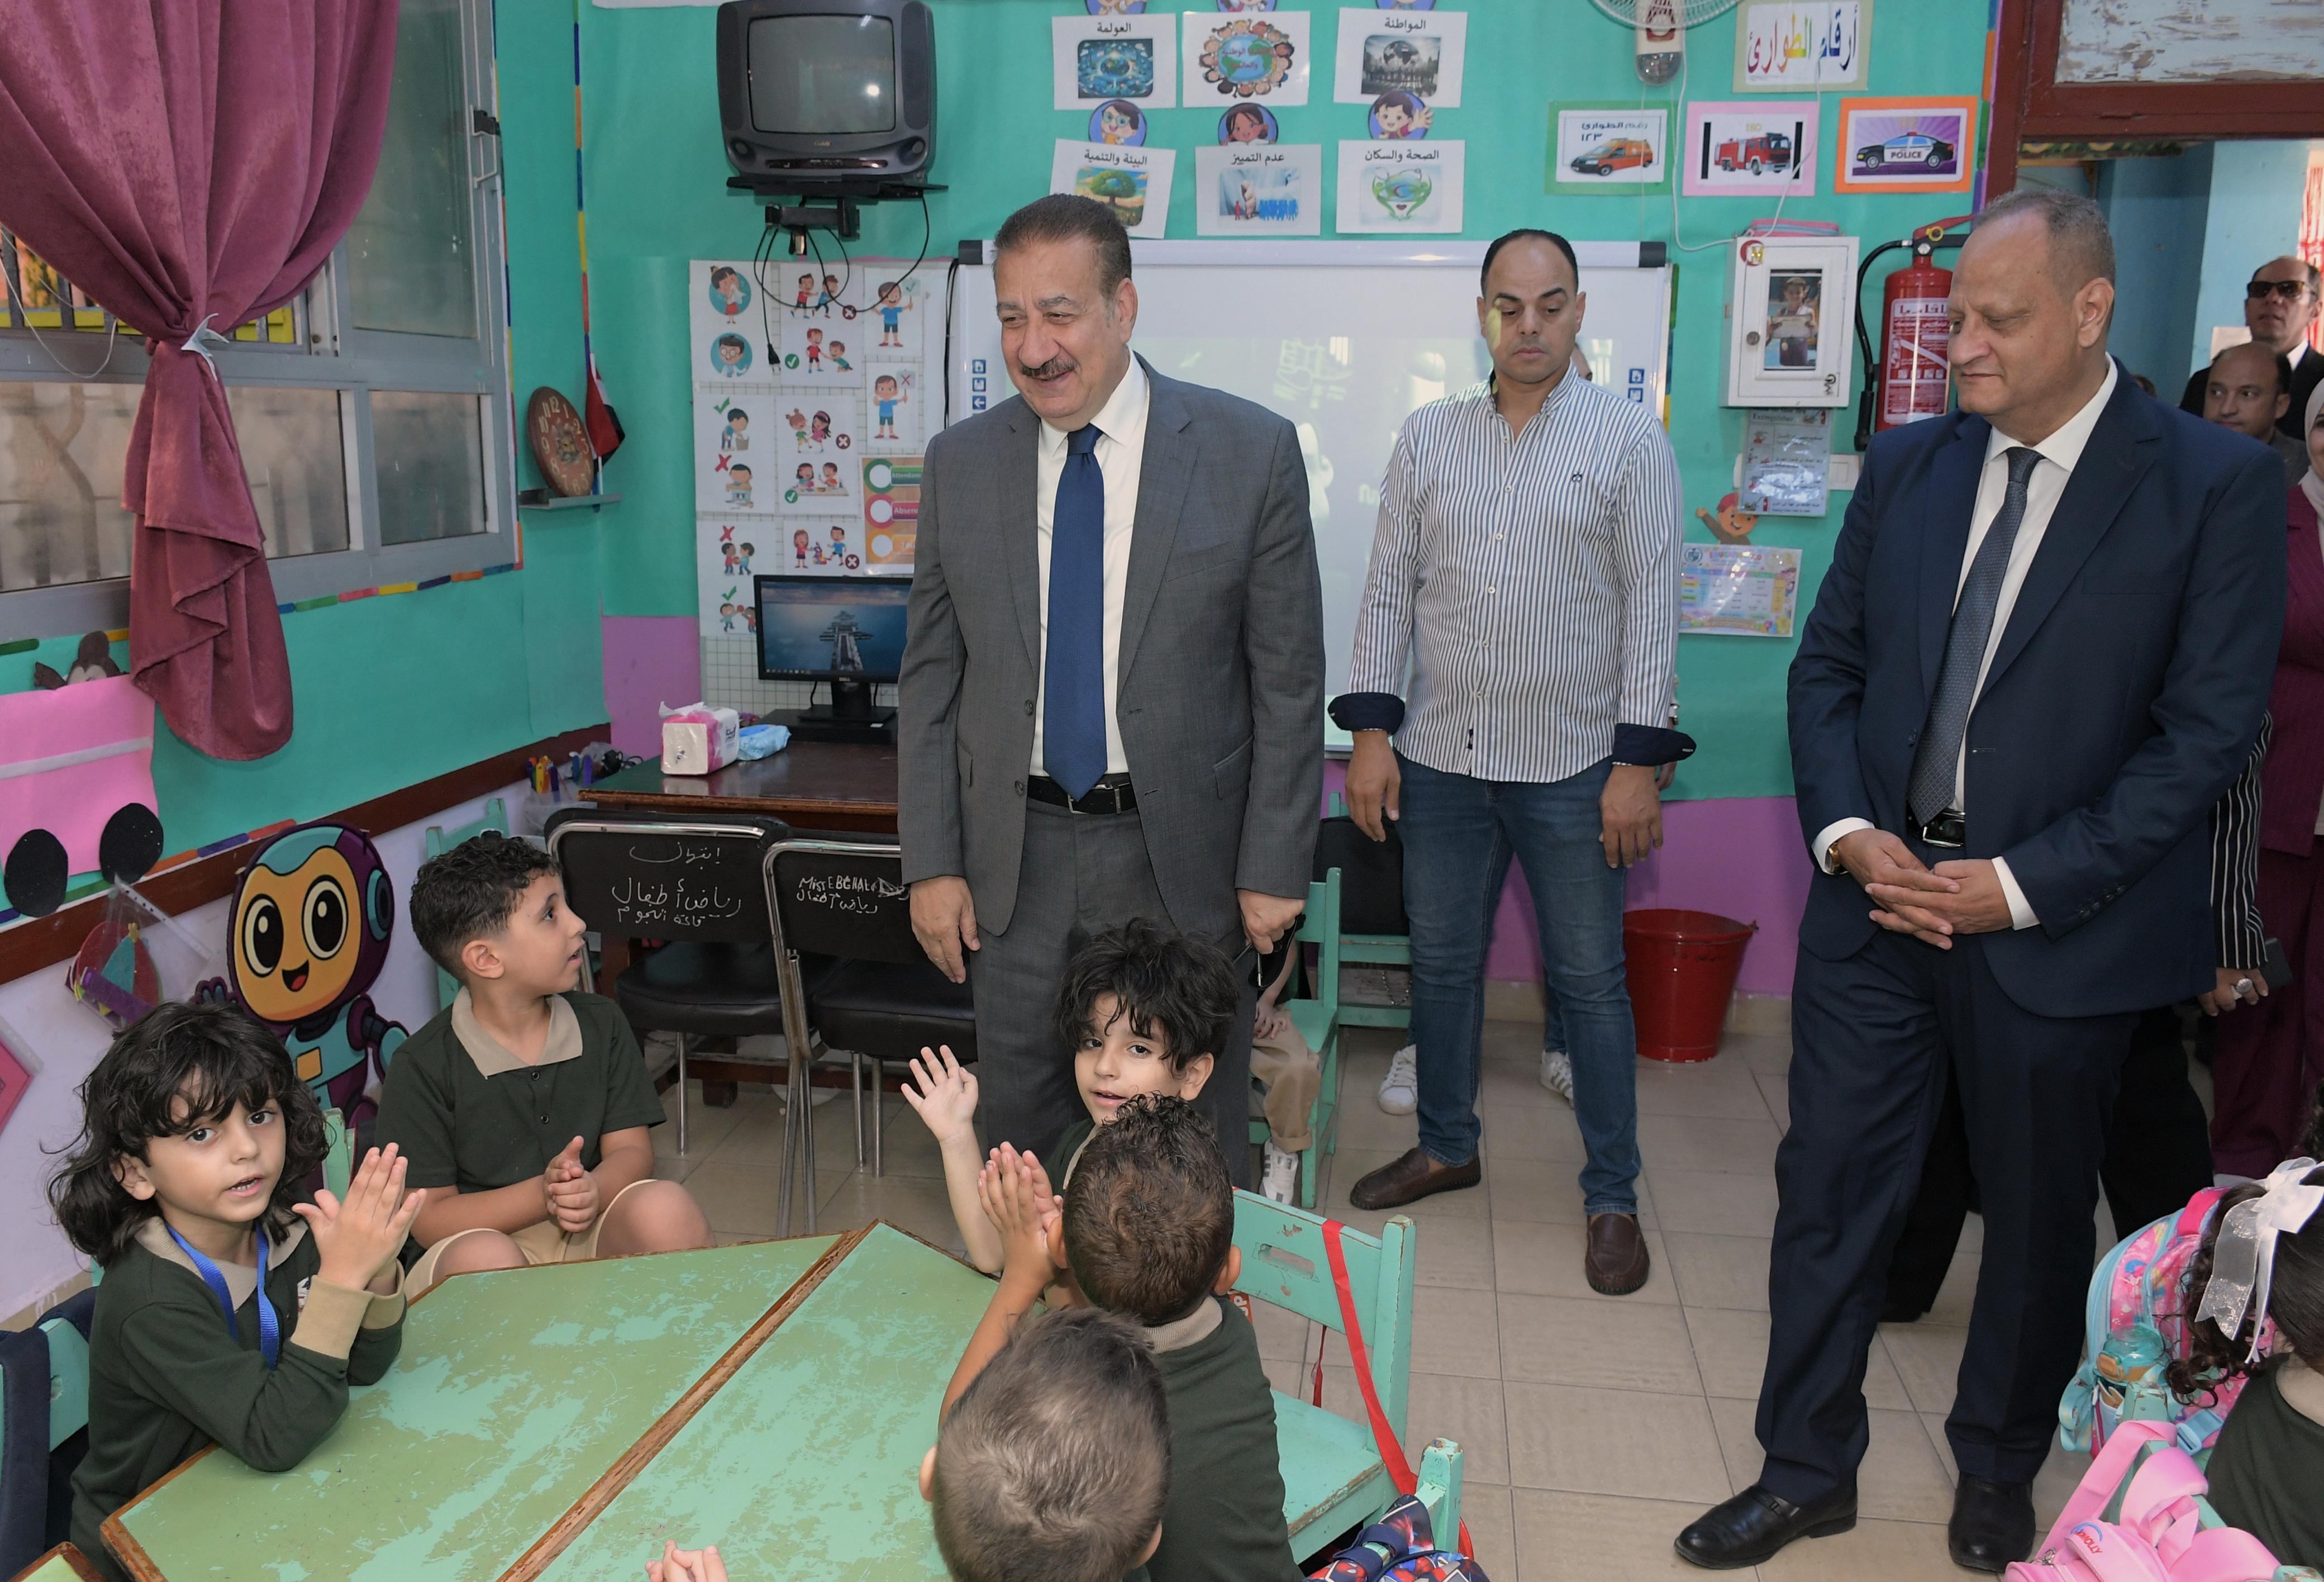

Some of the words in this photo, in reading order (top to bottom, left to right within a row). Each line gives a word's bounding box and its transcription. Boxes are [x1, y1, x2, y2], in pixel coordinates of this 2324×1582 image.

[1097, 22, 1131, 37] العولمة
[1384, 17, 1426, 33] المواطنة
[1818, 4, 1858, 79] أرقام
[1084, 149, 1120, 165] والتنمية
[1123, 153, 1148, 168] البيئة
[1231, 152, 1261, 165] التمييز
[1264, 154, 1284, 167] عدم
[1365, 149, 1403, 163] والسكان
[1406, 149, 1440, 160] الصحة
[1890, 151, 1922, 159] POLICE
[549, 396, 560, 414] 12
[541, 437, 550, 455] 9
[611, 877, 684, 908] أطفال
[684, 886, 741, 918] رياض
